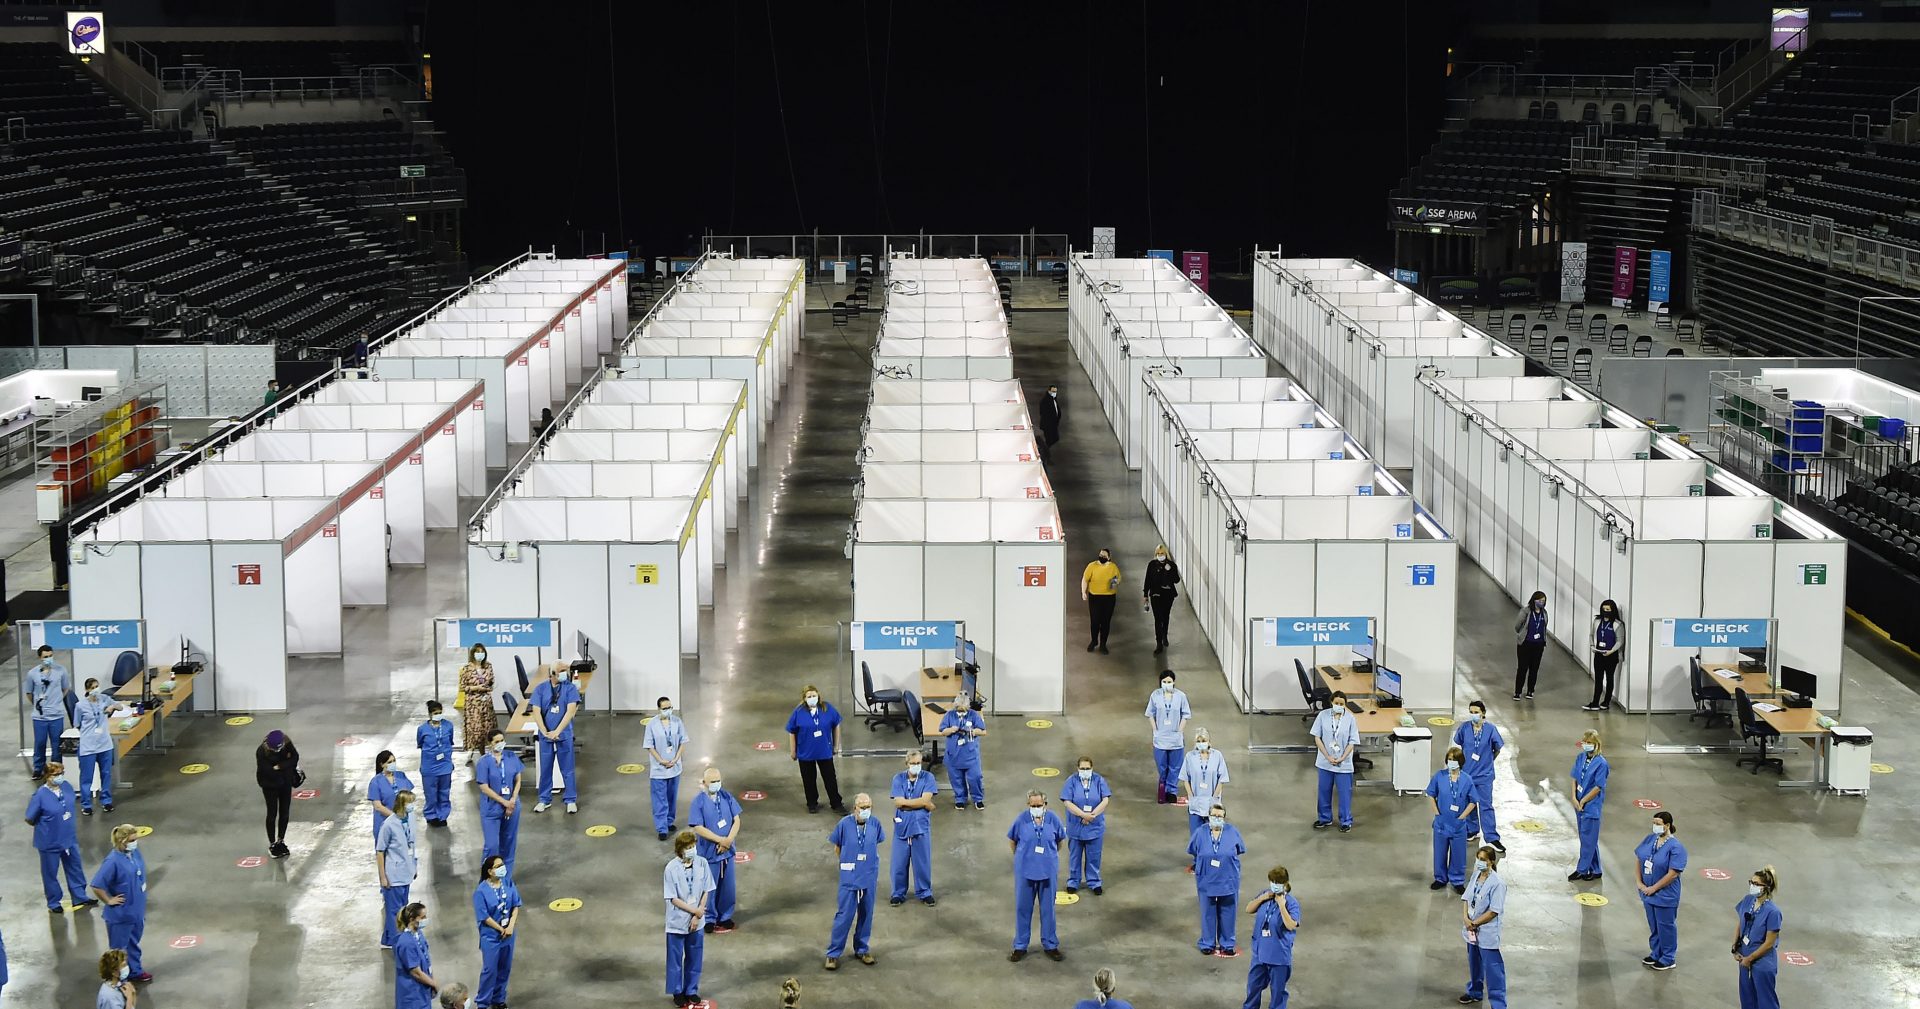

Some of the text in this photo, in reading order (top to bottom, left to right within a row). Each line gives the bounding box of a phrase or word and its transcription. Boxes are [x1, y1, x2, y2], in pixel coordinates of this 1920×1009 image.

[1396, 206, 1414, 216] THE
[1447, 210, 1477, 220] ARENA
[245, 576, 254, 584] A
[1031, 577, 1039, 585] C
[1419, 576, 1427, 584] D
[61, 625, 120, 635] CHECK
[475, 623, 534, 633] CHECK
[880, 625, 938, 636] CHECK
[1293, 621, 1351, 632] CHECK
[1691, 623, 1749, 633] CHECK
[82, 636, 100, 645] IN
[496, 634, 513, 644] IN
[900, 637, 918, 646] IN
[1313, 633, 1330, 642] IN
[1711, 635, 1728, 644] IN
